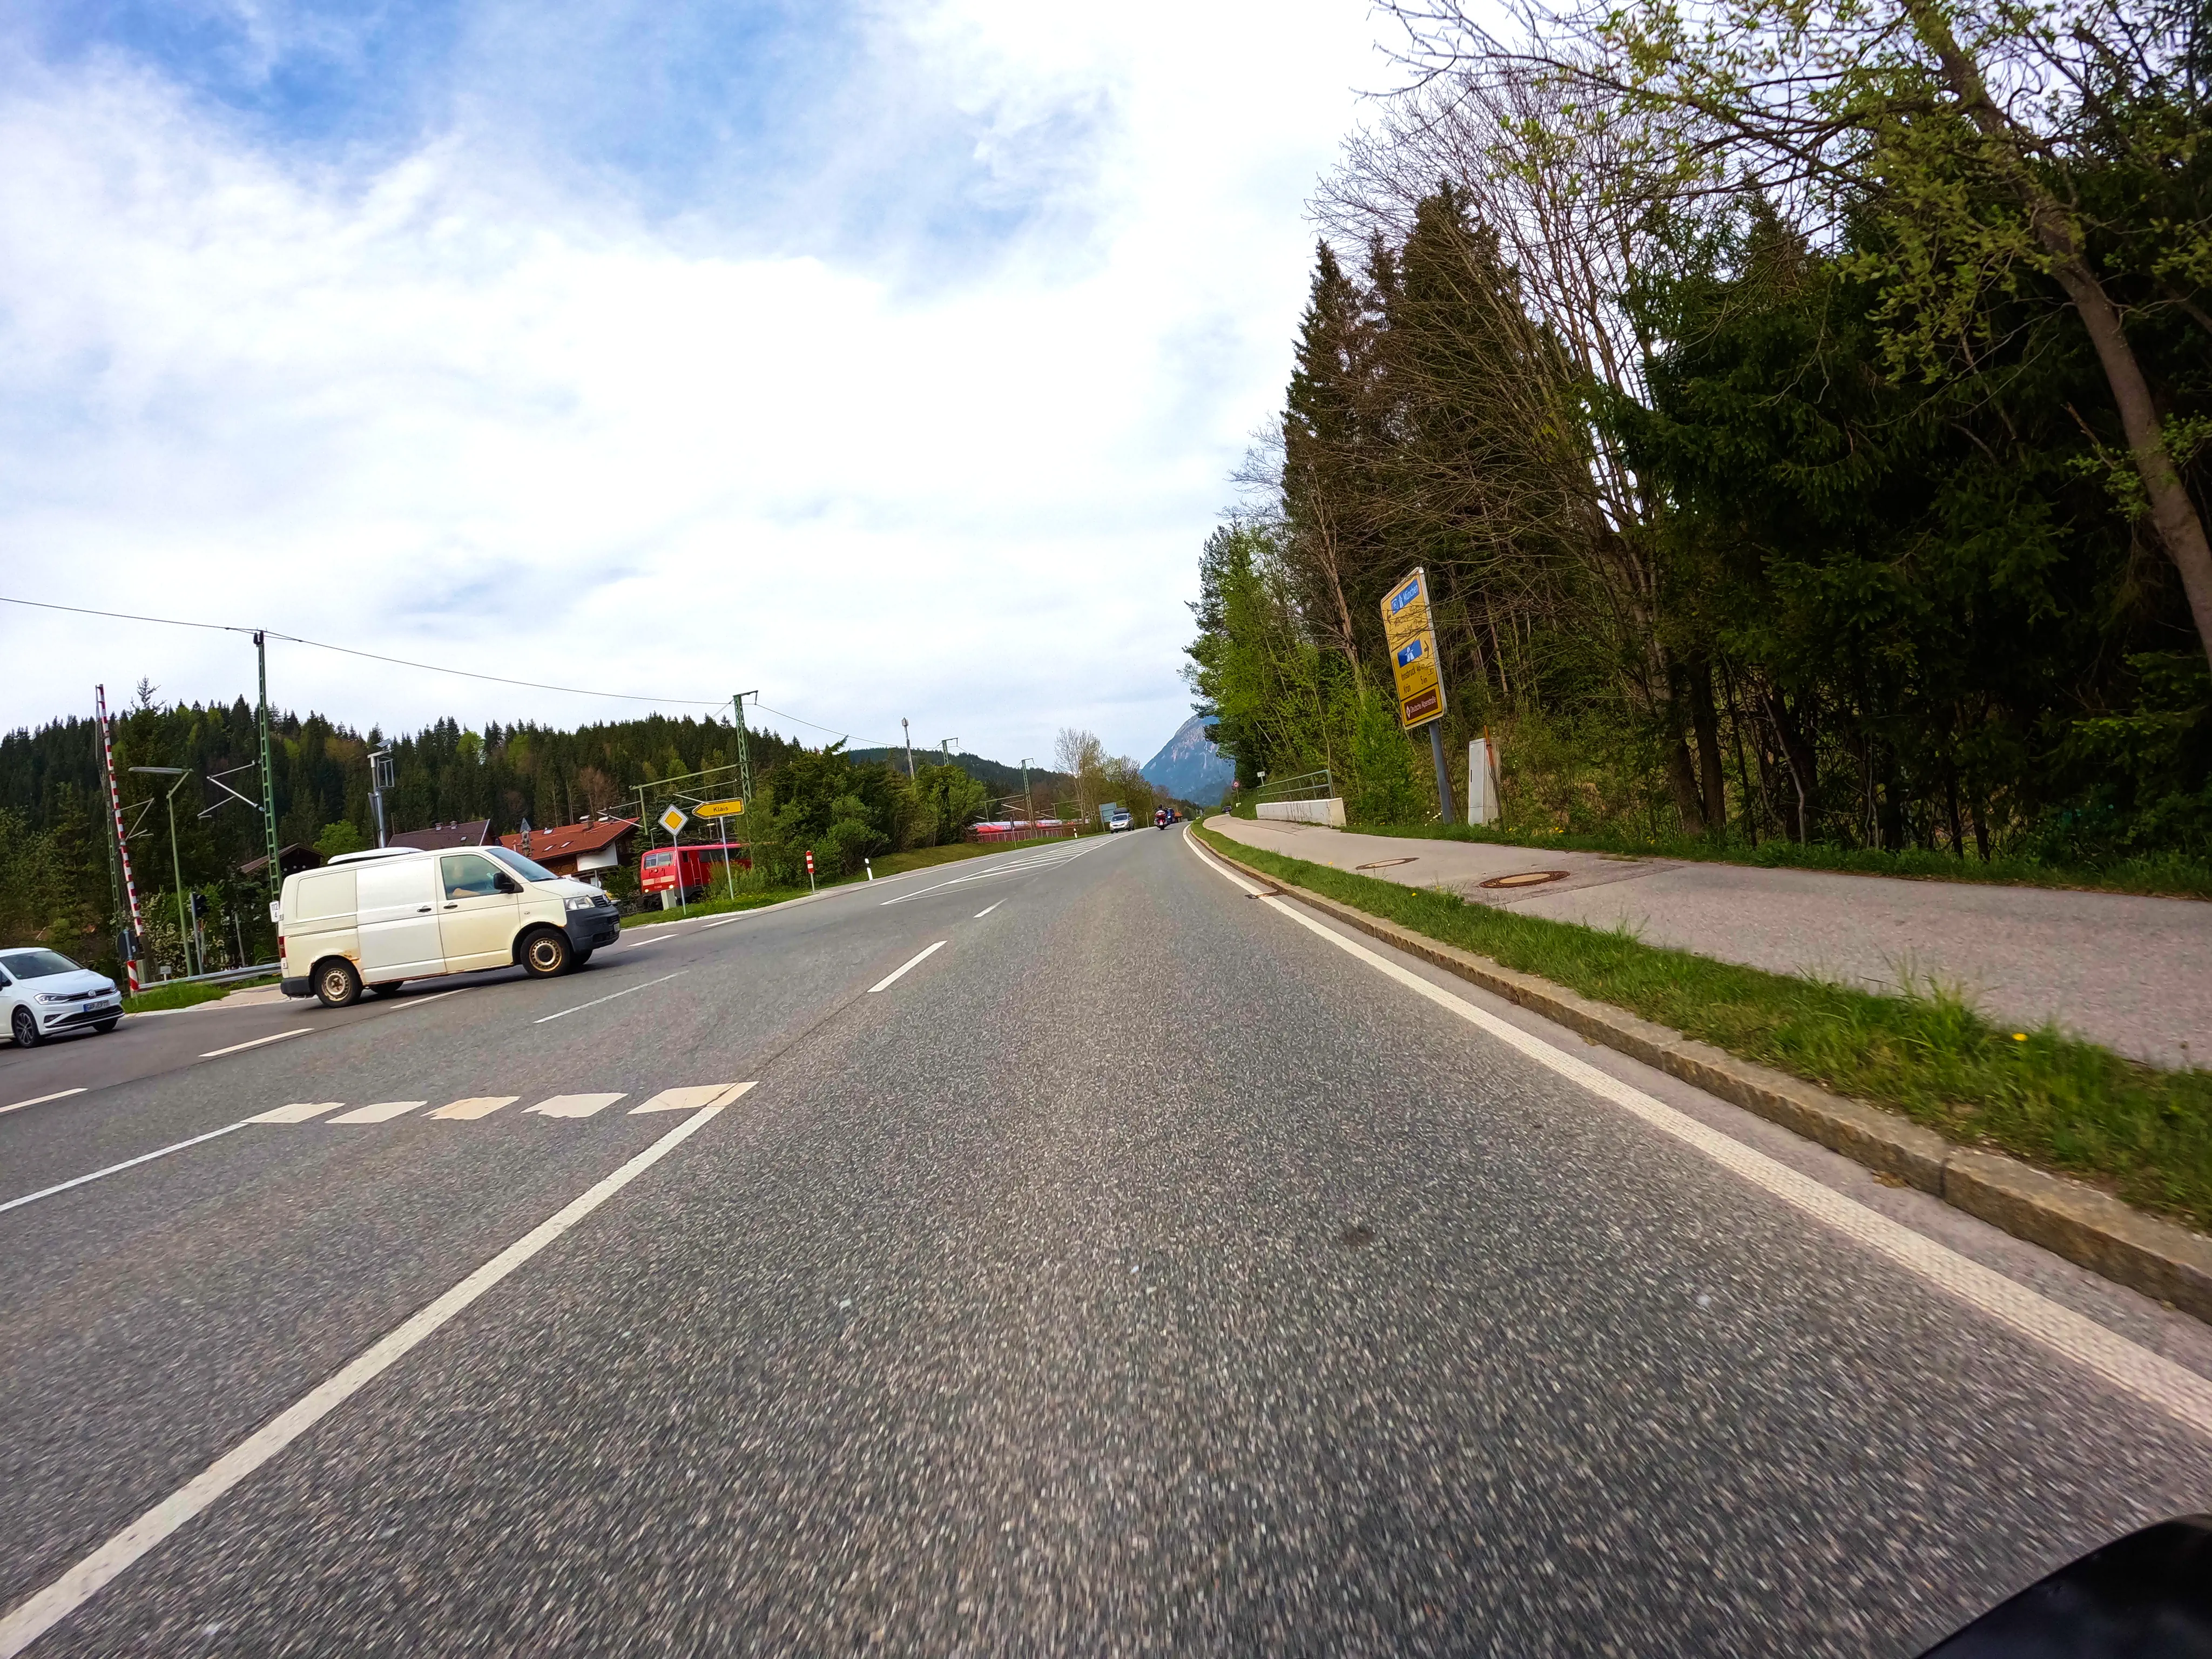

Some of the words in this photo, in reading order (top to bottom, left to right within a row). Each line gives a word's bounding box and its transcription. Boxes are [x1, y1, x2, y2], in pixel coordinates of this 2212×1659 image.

[1403, 585, 1418, 602] München
[1401, 666, 1415, 681] Innsbruck
[1420, 676, 1424, 685] 5
[1410, 703, 1421, 713] Deutsche
[1421, 696, 1436, 709] Alpenstraße
